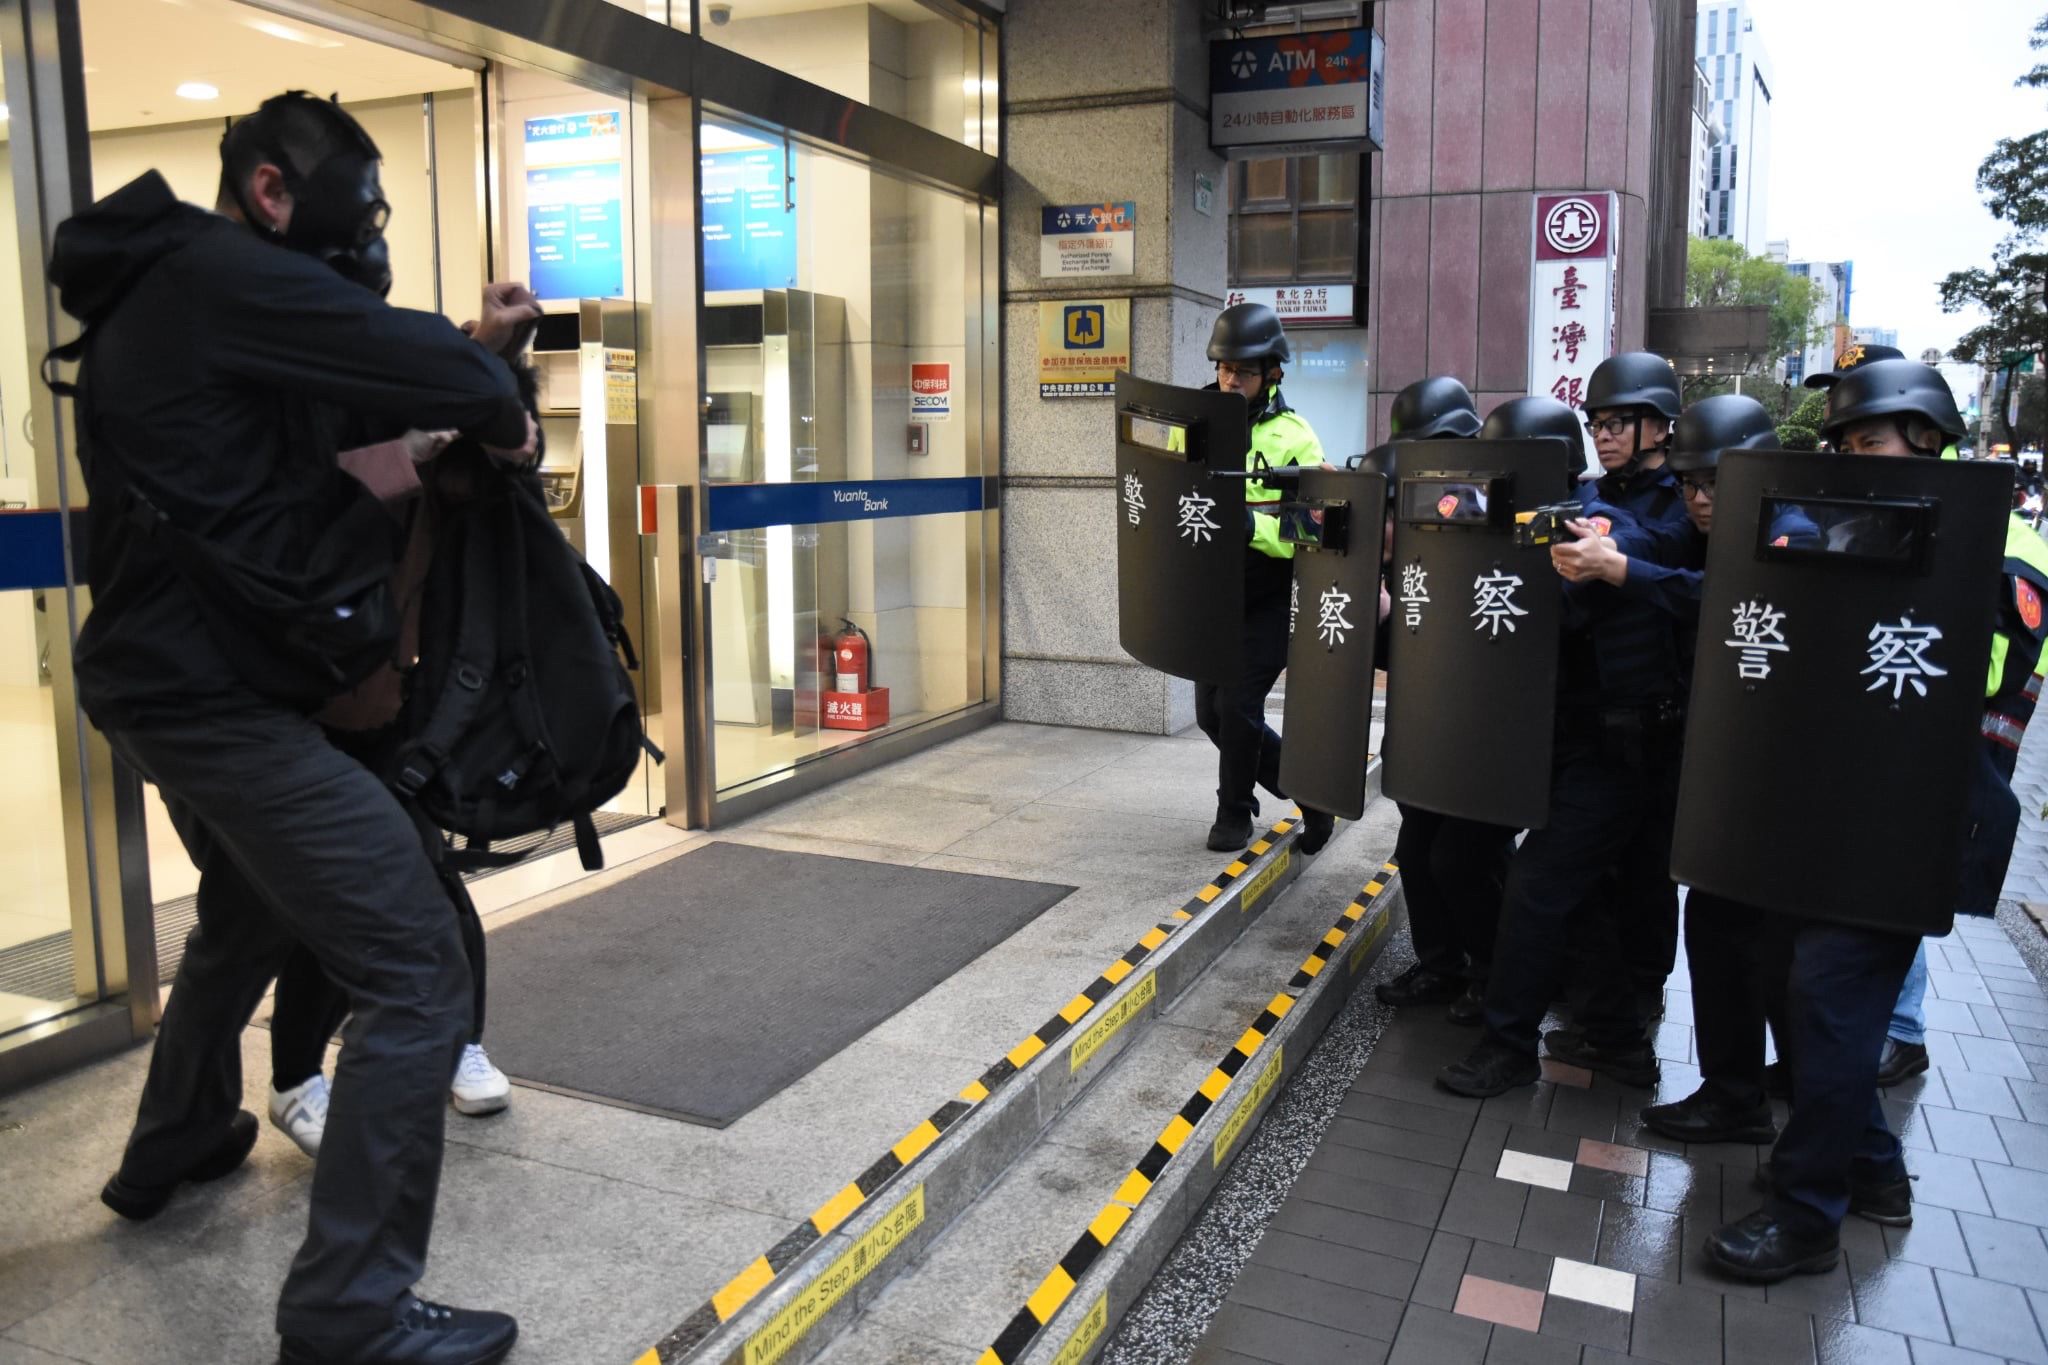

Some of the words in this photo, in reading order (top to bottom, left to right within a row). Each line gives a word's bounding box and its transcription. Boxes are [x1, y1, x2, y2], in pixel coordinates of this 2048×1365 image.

[1268, 48, 1316, 73] ATM
[1325, 55, 1348, 68] 24h
[1223, 105, 1355, 128] 24小時自動化服務區
[1075, 212, 1125, 226] 元大銀行
[1276, 288, 1328, 300] 敦化分行
[914, 378, 948, 390] 中保科技
[914, 396, 948, 406] SECOM
[833, 489, 868, 503] Yuanta
[864, 498, 889, 511] Bank
[1123, 473, 1147, 526] 警
[1176, 491, 1222, 543] 察
[1400, 563, 1431, 628] 警
[1470, 568, 1529, 636] 察
[1317, 586, 1354, 647] 察
[1725, 600, 1790, 680] 警
[1859, 617, 1948, 699] 察
[827, 701, 863, 716] 滅火器
[1074, 1037, 1092, 1059] Mind
[1092, 1027, 1104, 1044] the
[1104, 1012, 1120, 1033] Step
[754, 1318, 791, 1365] Mind
[794, 1298, 816, 1326] the
[819, 1265, 850, 1301] Step
[853, 1200, 919, 1274] 請小心台階
